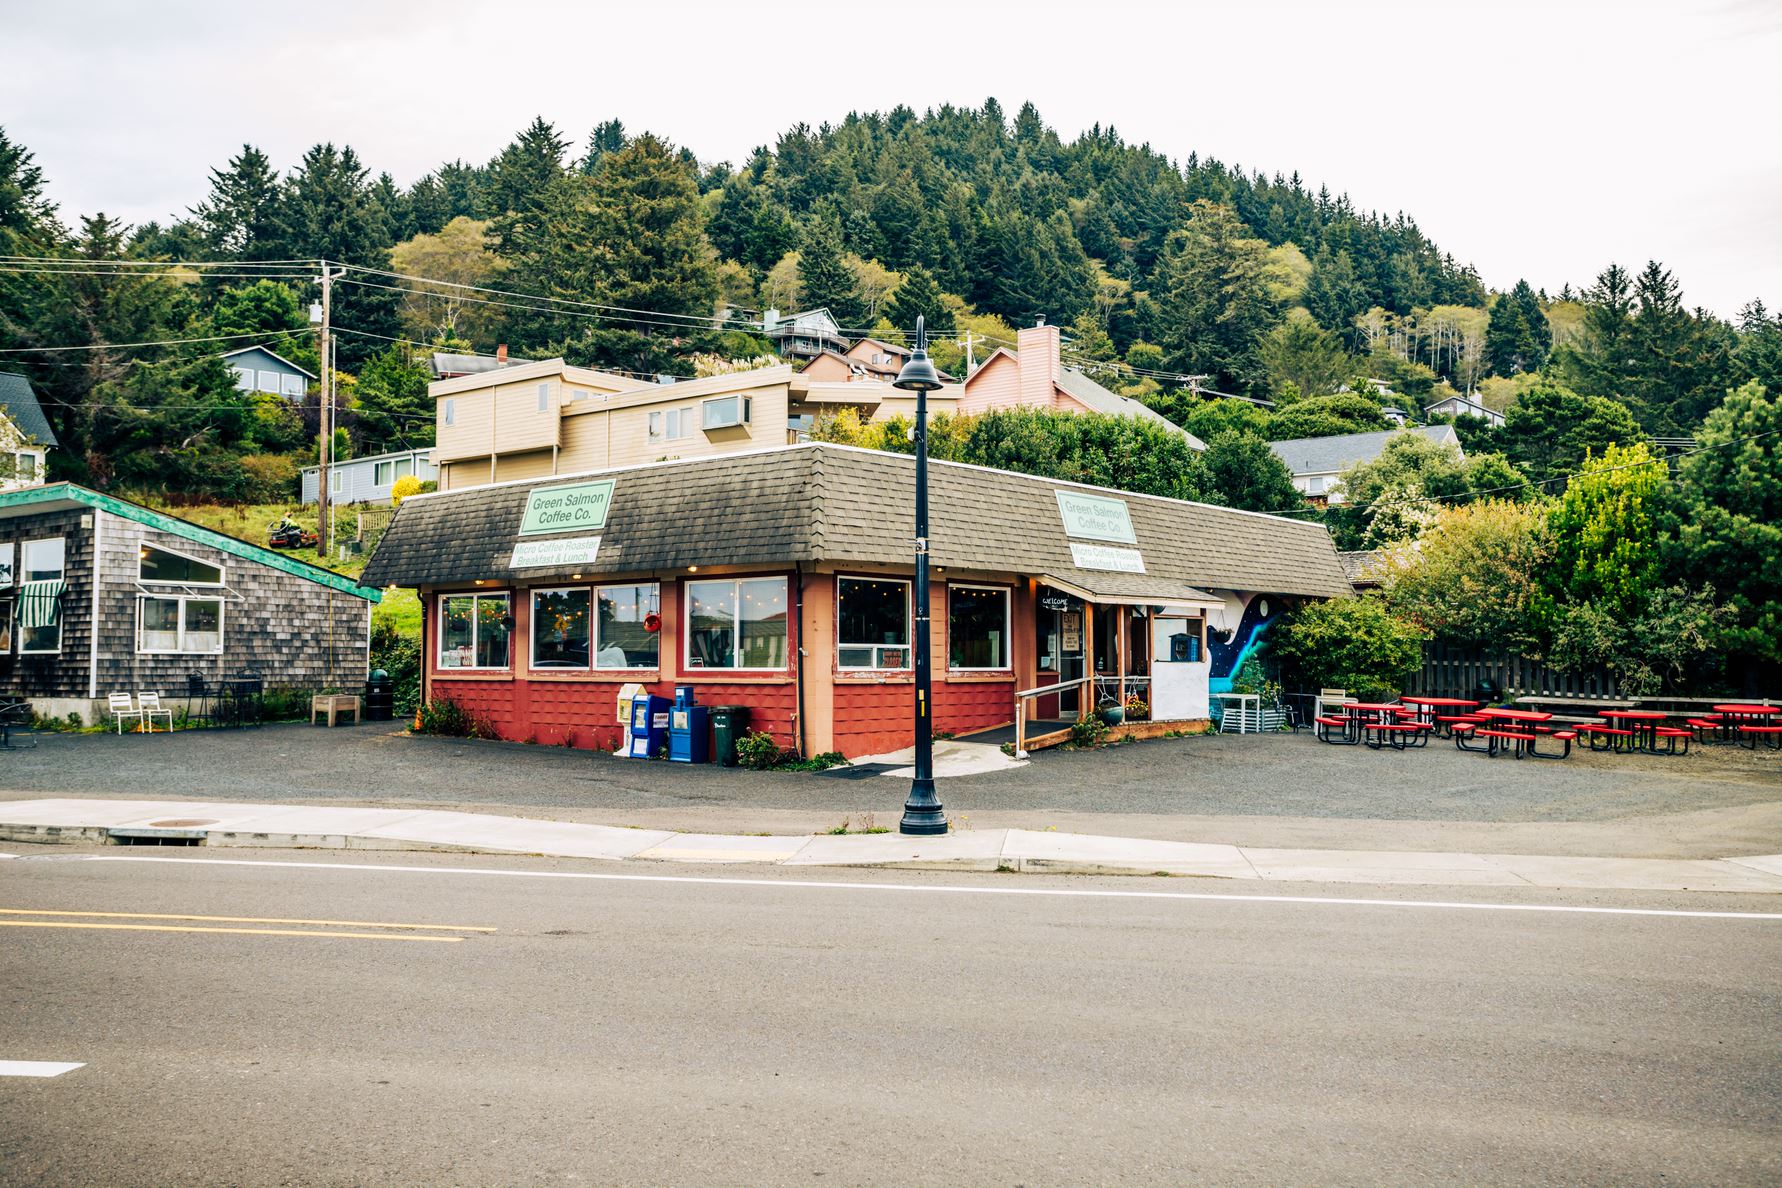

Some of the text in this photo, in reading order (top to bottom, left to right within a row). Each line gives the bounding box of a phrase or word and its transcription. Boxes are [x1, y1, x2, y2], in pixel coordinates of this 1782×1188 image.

[533, 493, 604, 510] Green Salmon
[539, 507, 591, 524] Coffee Co.
[1065, 500, 1125, 520] Green Salmon
[1078, 516, 1107, 531] Coffee
[515, 539, 599, 554] Micro Coffee Roaster
[516, 551, 588, 566] Breakfast & Lunch
